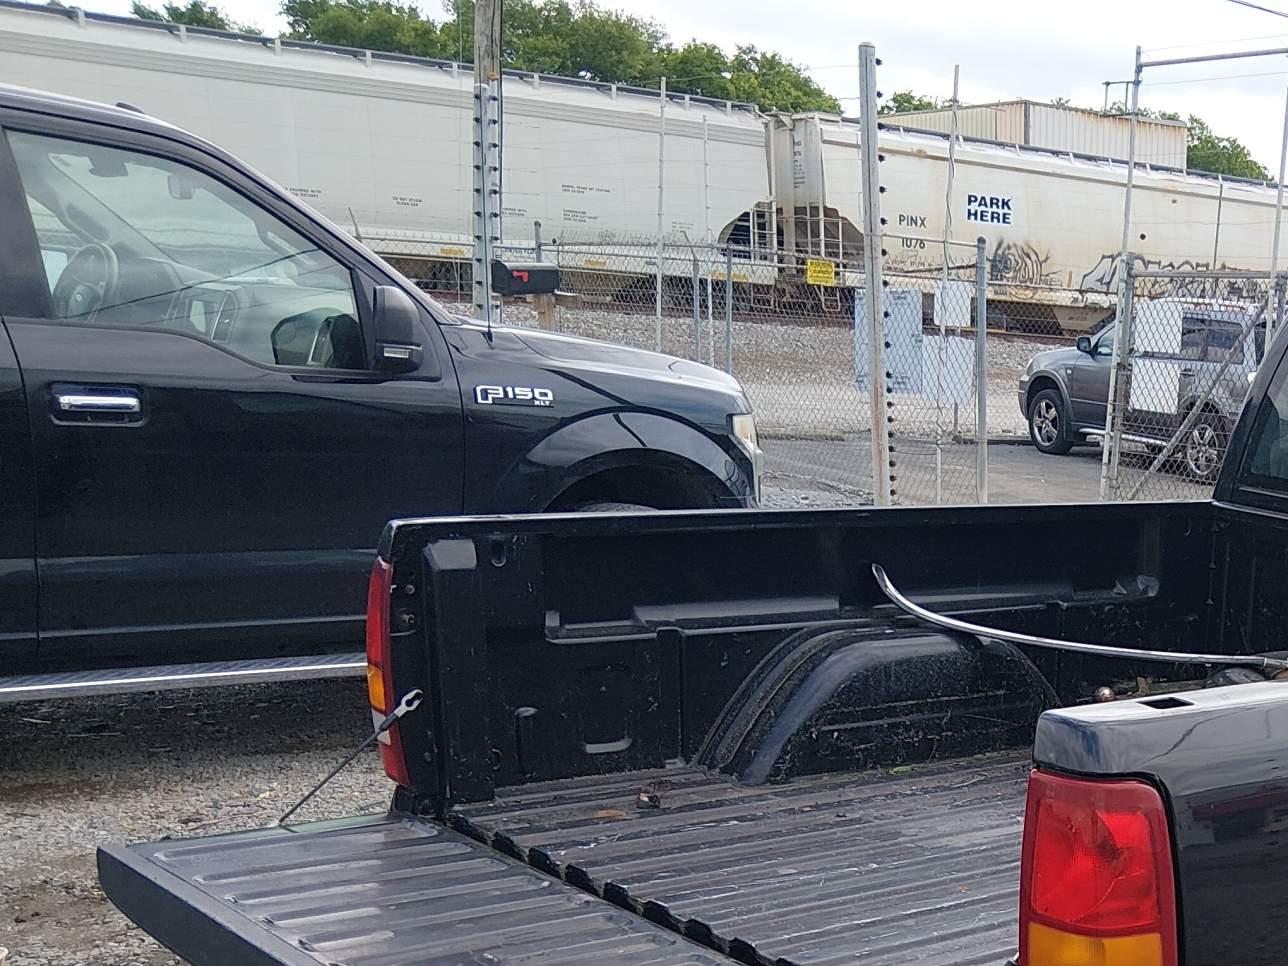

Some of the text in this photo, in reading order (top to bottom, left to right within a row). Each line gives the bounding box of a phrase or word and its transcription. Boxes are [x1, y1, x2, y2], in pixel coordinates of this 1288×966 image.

[967, 194, 1012, 210] PARK
[898, 214, 927, 228] PINX
[967, 209, 1012, 224] HERE
[901, 238, 926, 249] 1076
